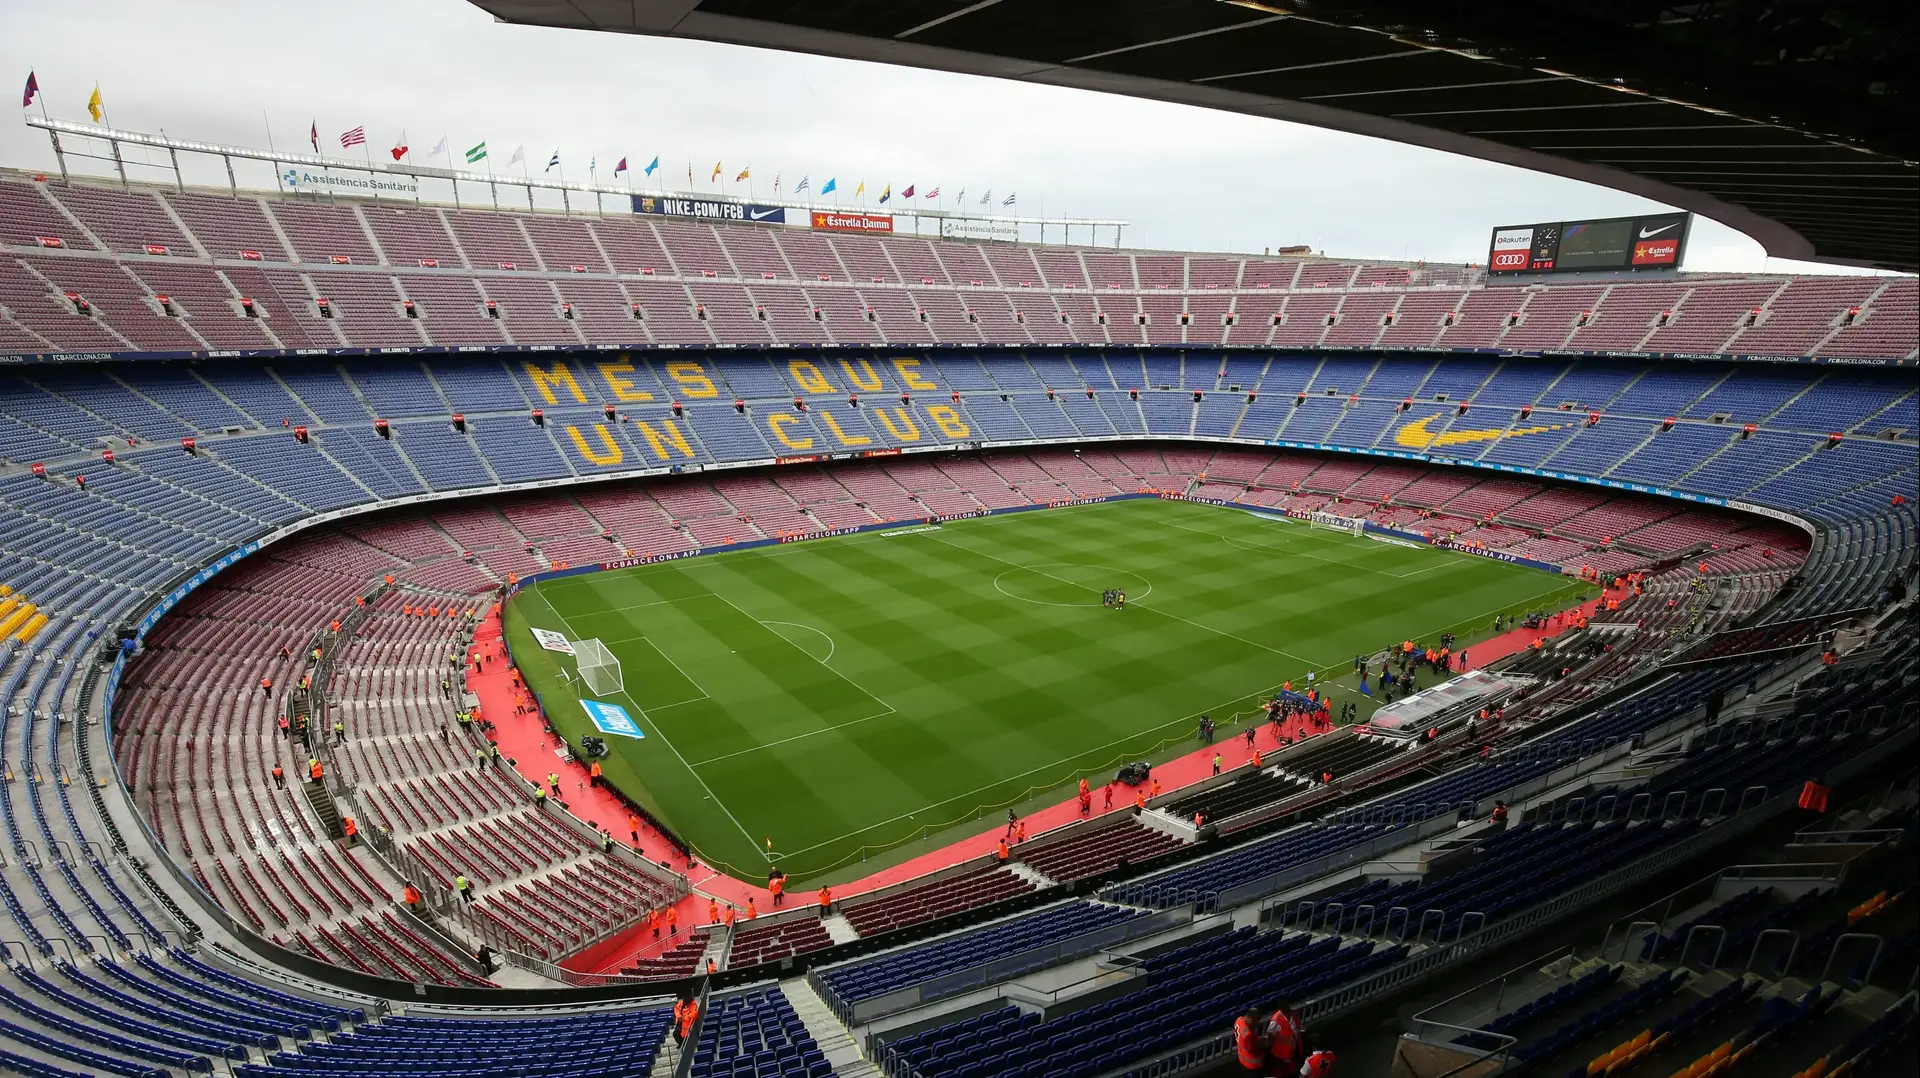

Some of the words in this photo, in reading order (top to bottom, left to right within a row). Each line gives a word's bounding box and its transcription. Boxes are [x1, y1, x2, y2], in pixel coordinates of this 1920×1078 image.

[303, 173, 368, 188] Assistència
[369, 179, 417, 192] Sanitària
[663, 199, 744, 218] NIKE.COM/FCB
[827, 215, 862, 229] Estrella
[863, 216, 890, 229] Damm
[1502, 236, 1531, 244] Rakuten
[1648, 246, 1674, 255] Estrella
[53, 353, 112, 361] FCBARCELONA.COM
[524, 353, 719, 405] MÉS
[788, 358, 937, 393] QUE
[564, 419, 696, 466] UN
[768, 405, 970, 450] CLUB
[1632, 484, 1648, 492] beko
[1656, 488, 1672, 497] beko
[1161, 494, 1210, 504] FCBARCELONA
[1680, 492, 1696, 501] beko
[1705, 496, 1722, 505] beko
[1726, 500, 1753, 511] KONAMI
[1760, 508, 1782, 519] KONAMI
[782, 529, 841, 543] FCBARCELONA
[606, 553, 679, 569] FCBARCELONA
[683, 550, 701, 558] APP
[1498, 554, 1517, 562] APP
